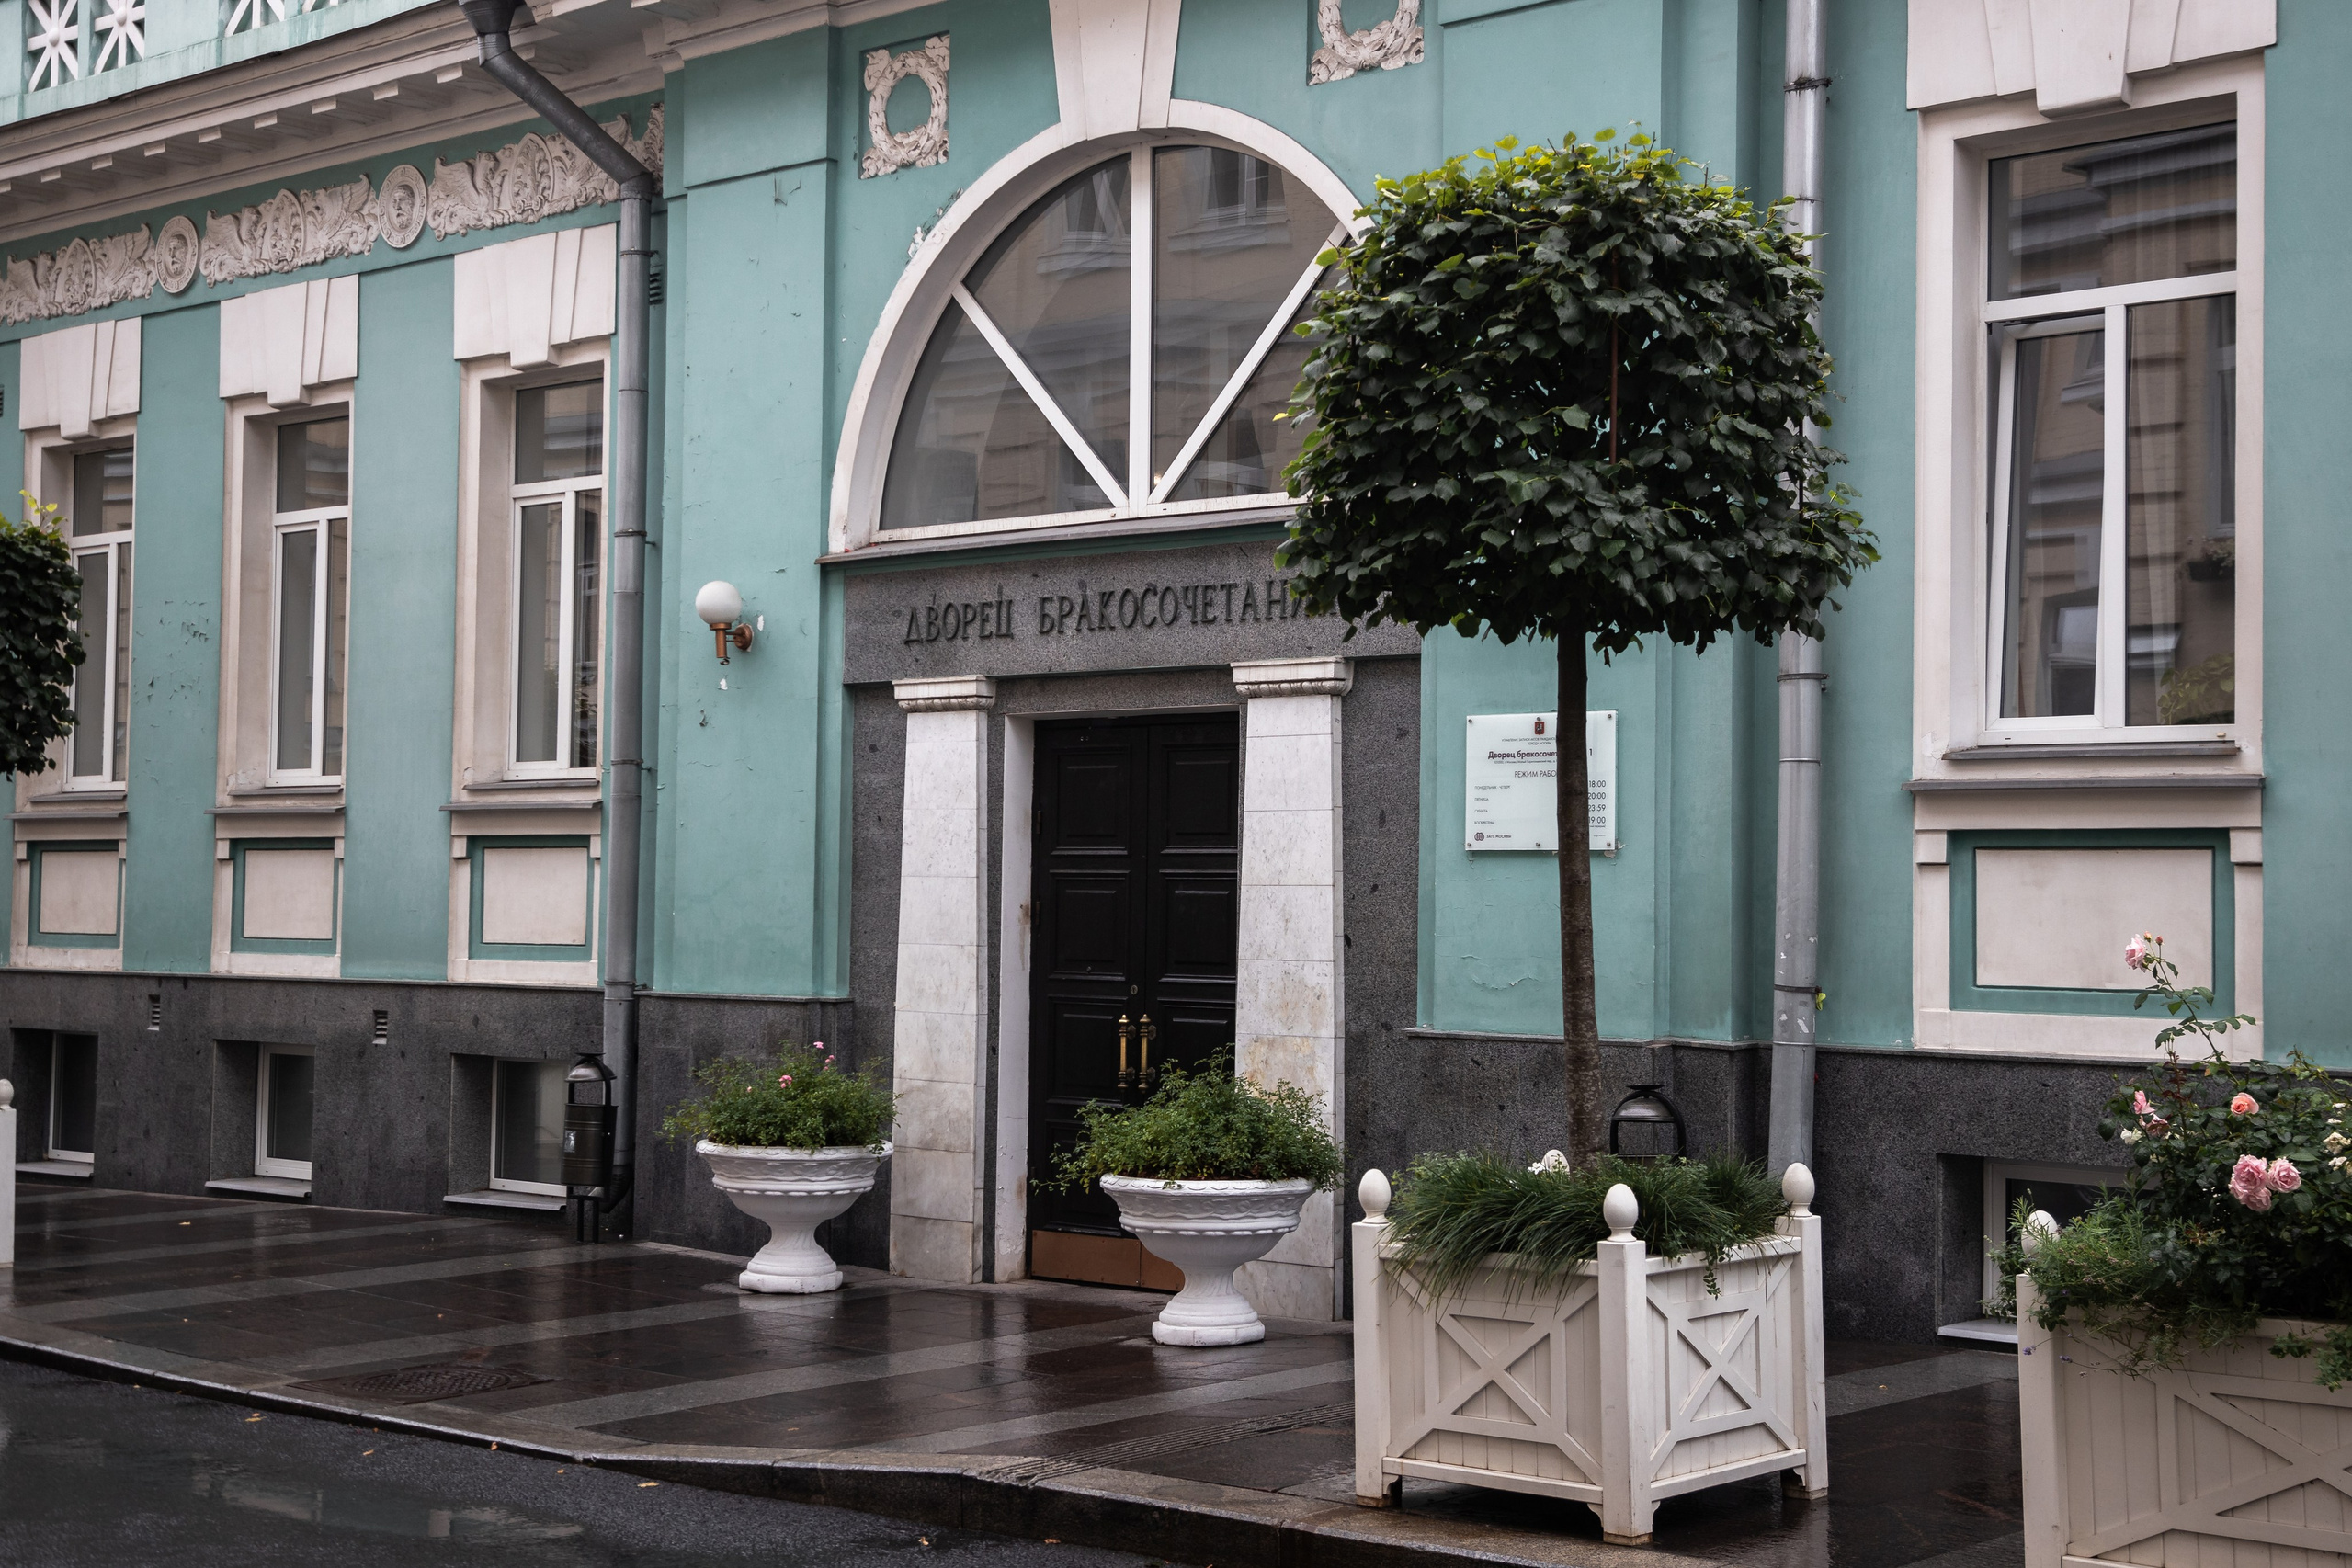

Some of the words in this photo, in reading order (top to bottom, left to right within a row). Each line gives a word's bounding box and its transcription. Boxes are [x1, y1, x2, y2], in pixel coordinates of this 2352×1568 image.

[903, 599, 1014, 644] ДВОРЕЦ
[1039, 578, 1337, 634] БРАКОСОЧЕТАН
[1488, 751, 1516, 759] Дворец
[1517, 750, 1558, 759] бракосочет
